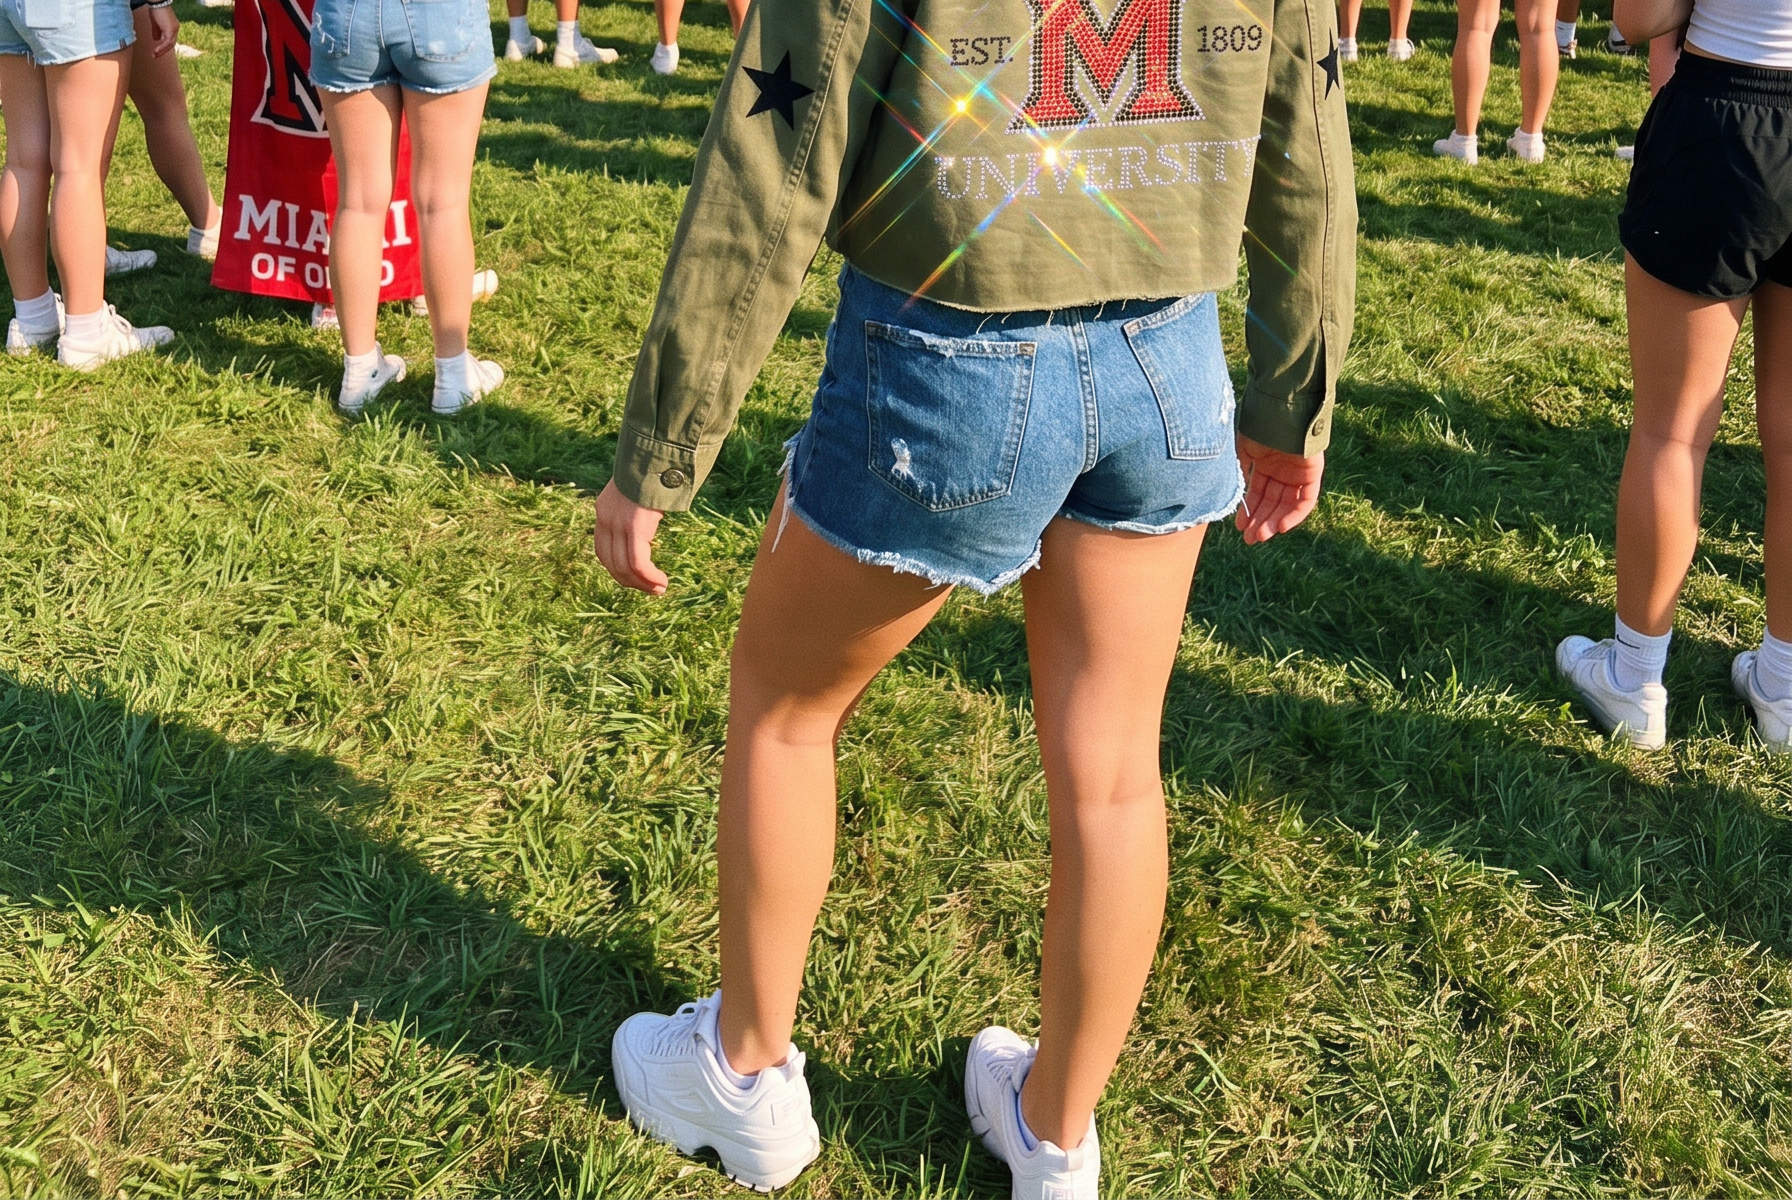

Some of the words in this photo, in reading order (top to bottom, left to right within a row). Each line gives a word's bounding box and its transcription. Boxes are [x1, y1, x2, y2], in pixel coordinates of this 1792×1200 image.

[949, 35, 1014, 66] EST.
[1197, 24, 1263, 54] 1809
[233, 194, 413, 255] MIAI
[251, 252, 296, 282] OF
